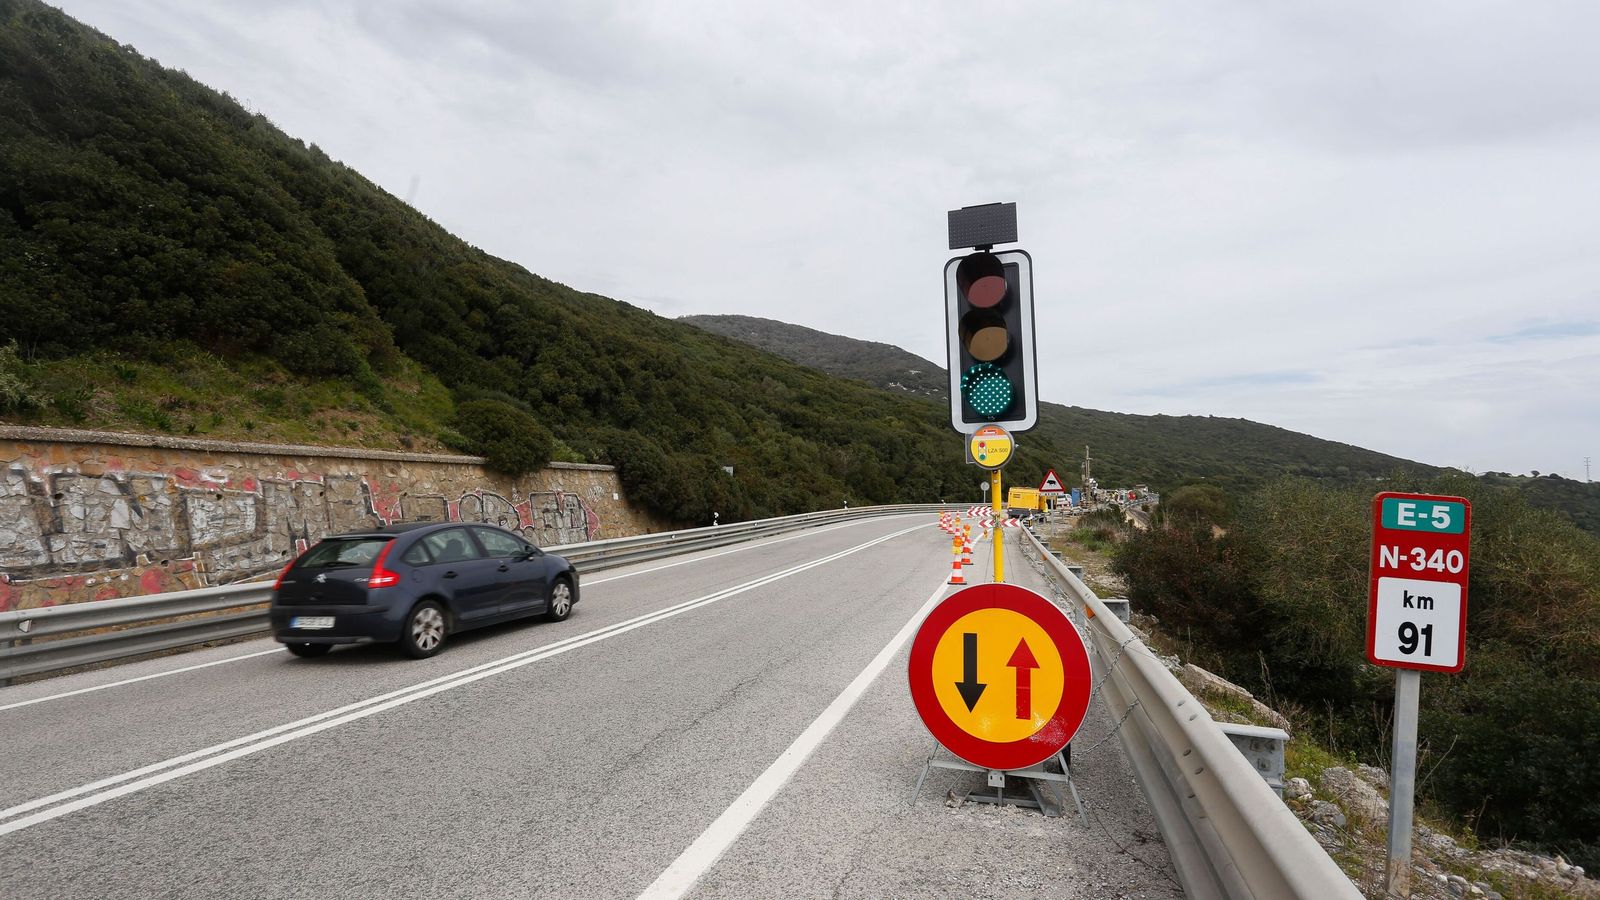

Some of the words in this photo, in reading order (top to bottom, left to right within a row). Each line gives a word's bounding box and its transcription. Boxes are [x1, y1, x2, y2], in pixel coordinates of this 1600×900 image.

[1397, 502, 1451, 530] E-5
[1379, 545, 1464, 574] N-340
[1403, 590, 1434, 610] km
[1398, 621, 1433, 657] 91
